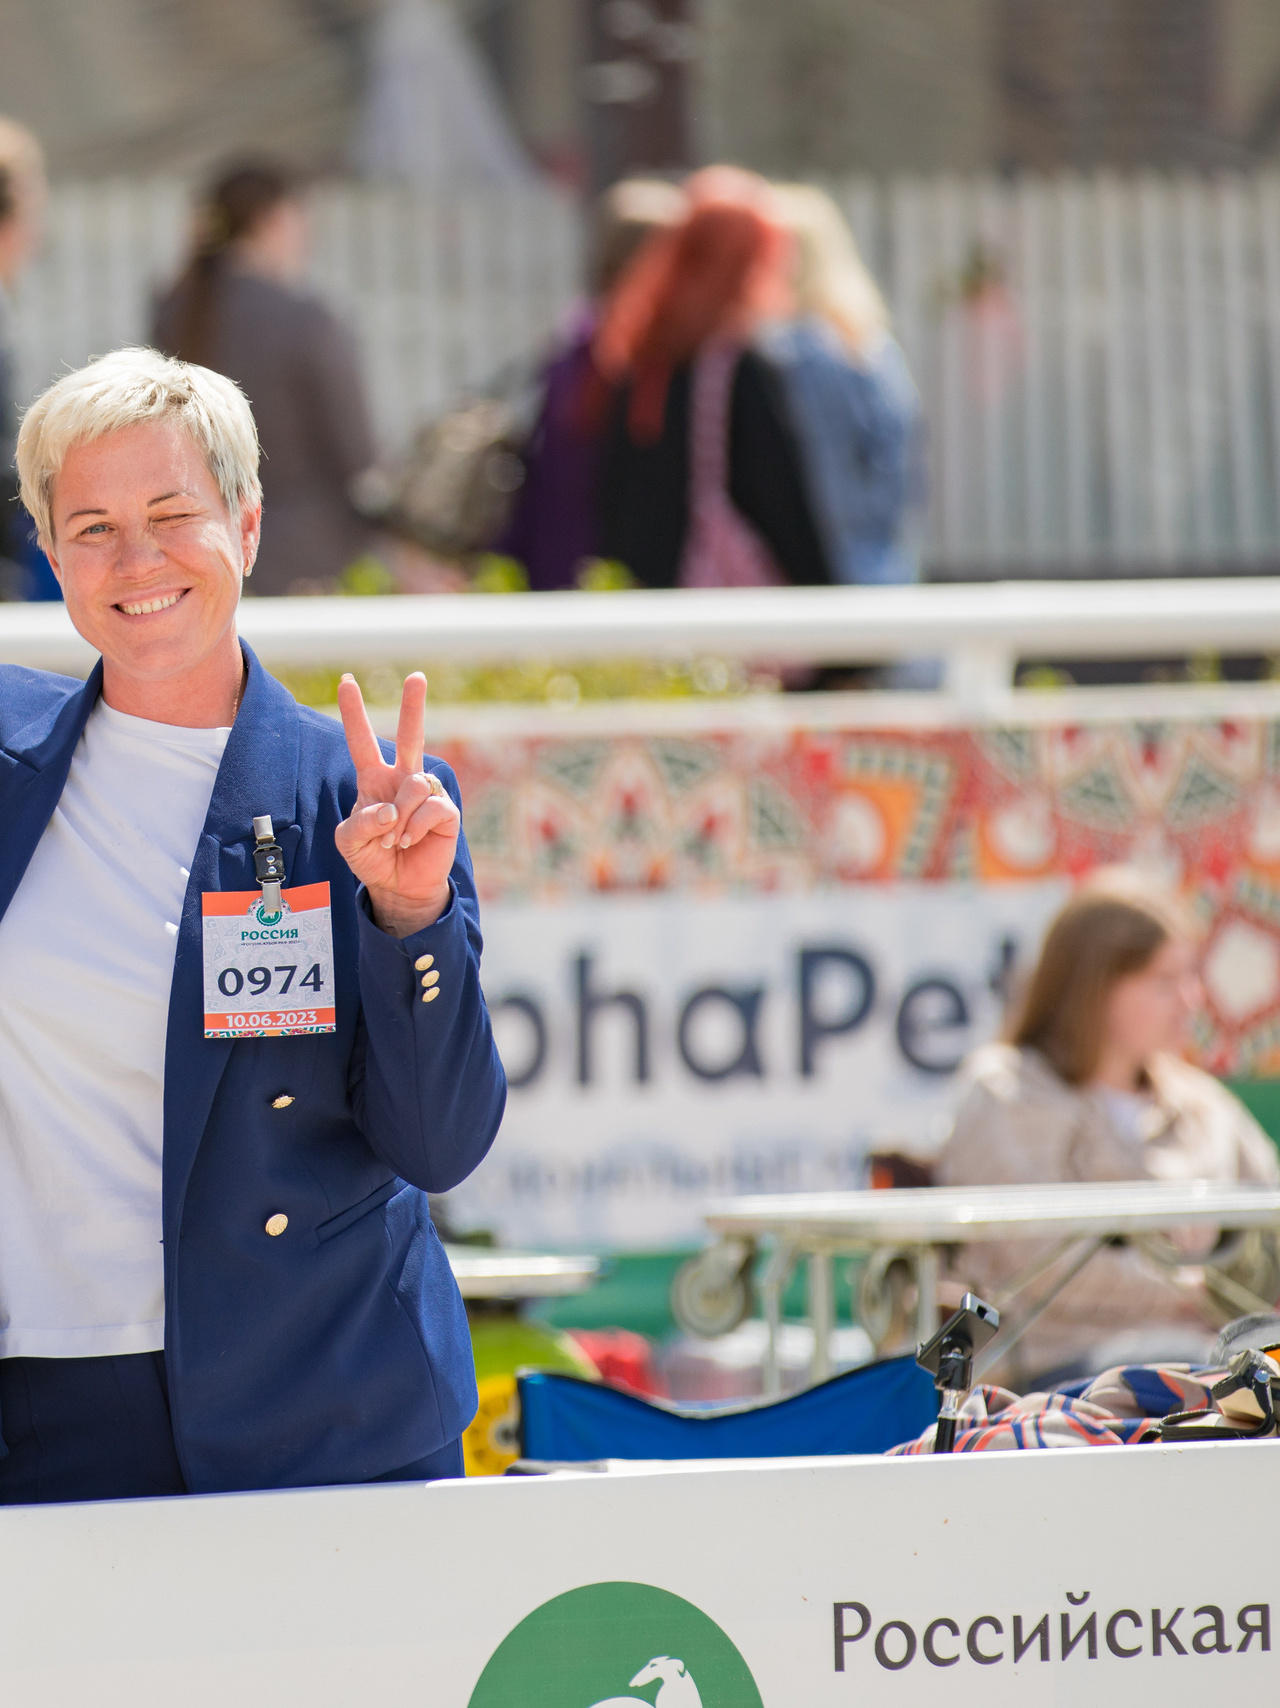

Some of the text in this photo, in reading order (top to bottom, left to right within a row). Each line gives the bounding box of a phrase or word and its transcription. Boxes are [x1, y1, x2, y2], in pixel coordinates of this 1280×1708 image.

[241, 928, 298, 940] РОССИЯ
[218, 963, 324, 997] 0974
[226, 1011, 317, 1027] 10.06.2023
[833, 1591, 1271, 1672] Российская
